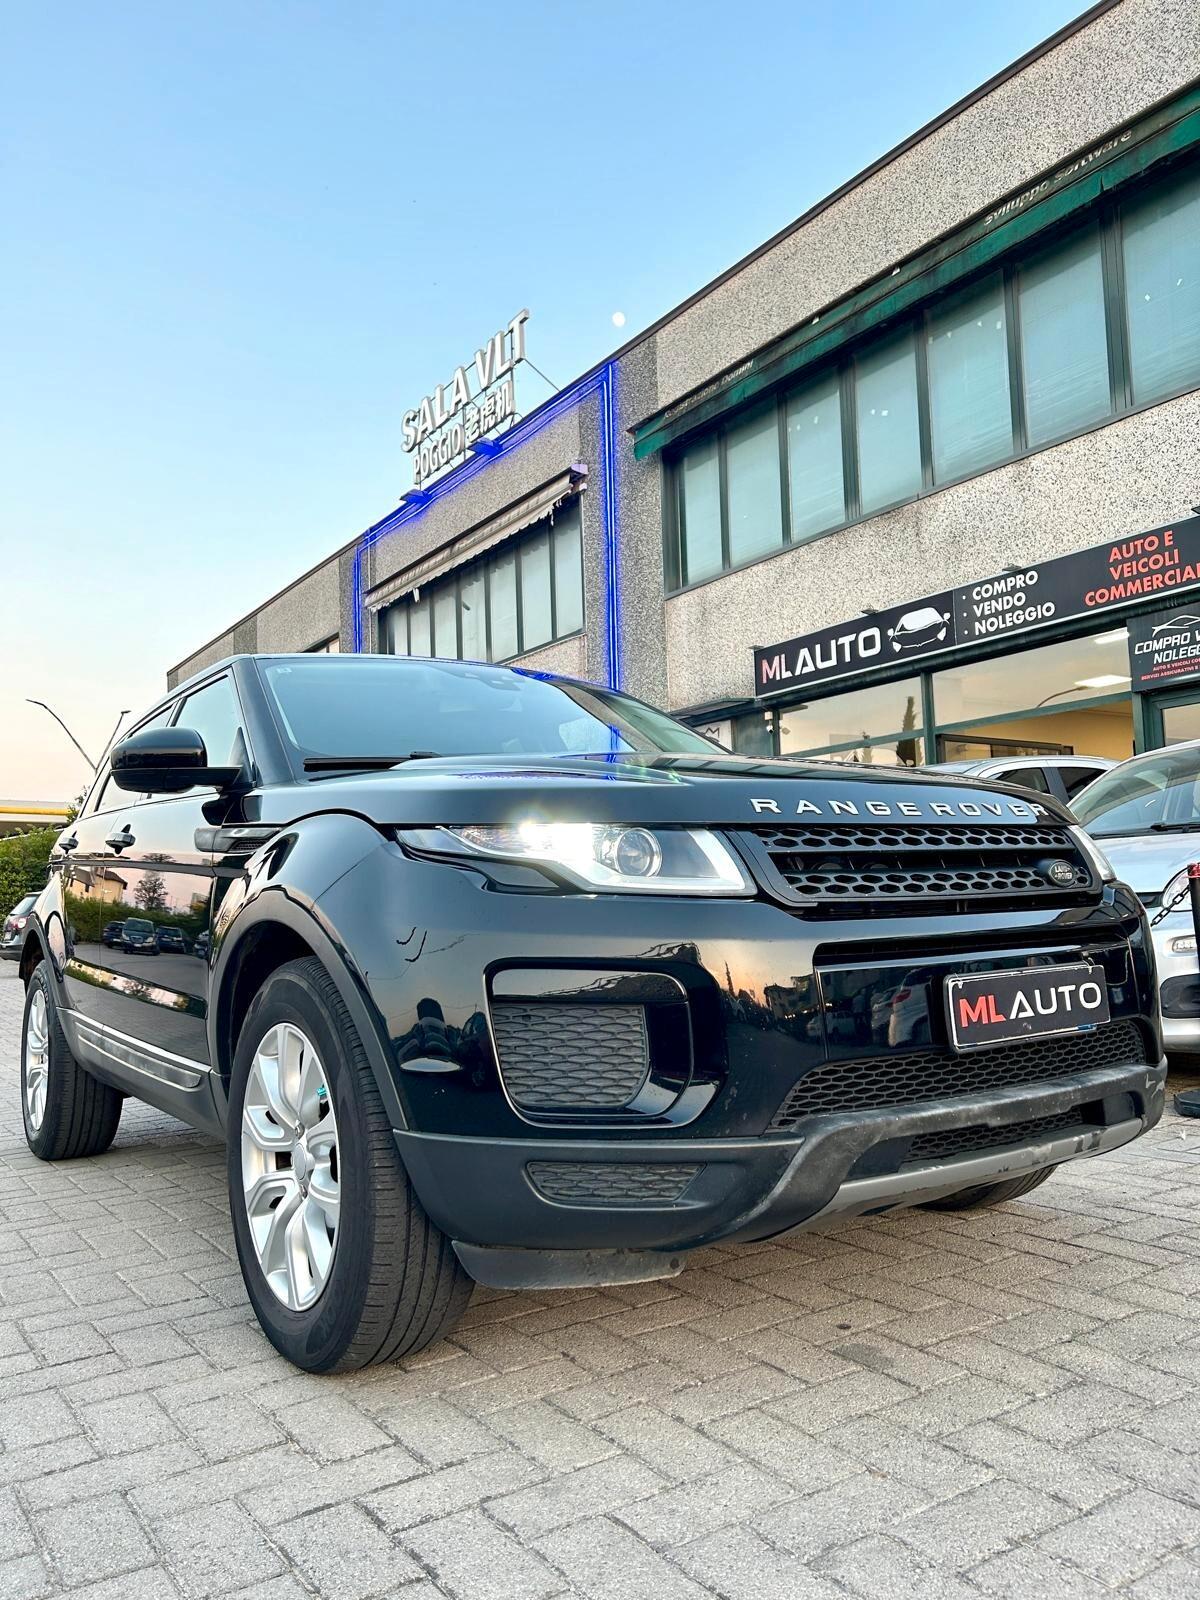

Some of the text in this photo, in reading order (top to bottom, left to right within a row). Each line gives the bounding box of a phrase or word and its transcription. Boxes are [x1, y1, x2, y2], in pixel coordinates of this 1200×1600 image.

[401, 308, 529, 453] SALA VLT
[465, 380, 515, 442] 老虎机
[413, 423, 464, 484] POGGIO
[1109, 530, 1174, 562] AUTO E
[1110, 549, 1180, 581] VEICOLI
[973, 570, 1039, 600] COMPRO
[973, 592, 1027, 617] VENDO
[974, 601, 1056, 636] NOLEGGIO
[1134, 632, 1191, 655] COMPRO
[750, 798, 1050, 817] RANGE ROVER
